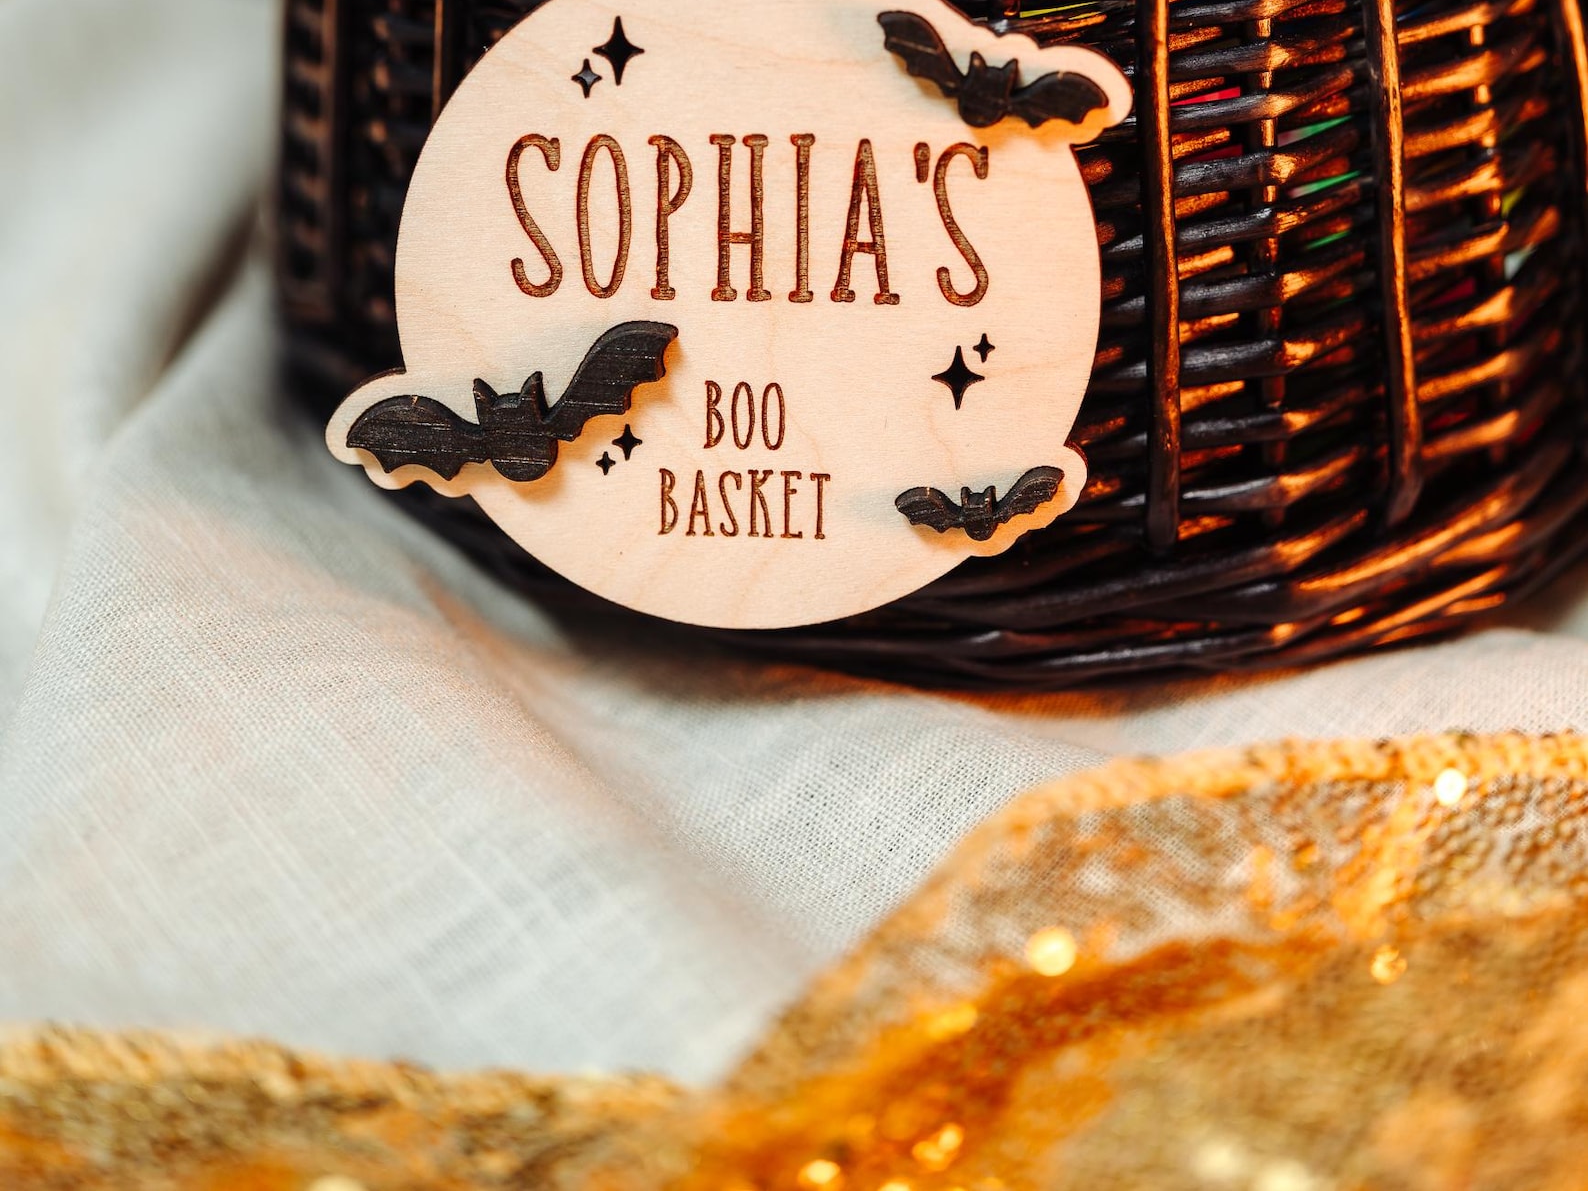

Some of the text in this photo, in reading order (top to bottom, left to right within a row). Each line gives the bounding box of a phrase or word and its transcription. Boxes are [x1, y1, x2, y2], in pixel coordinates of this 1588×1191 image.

[506, 133, 989, 307] SOPHIA'S
[704, 380, 786, 451] BOO
[658, 468, 831, 540] BASKET
